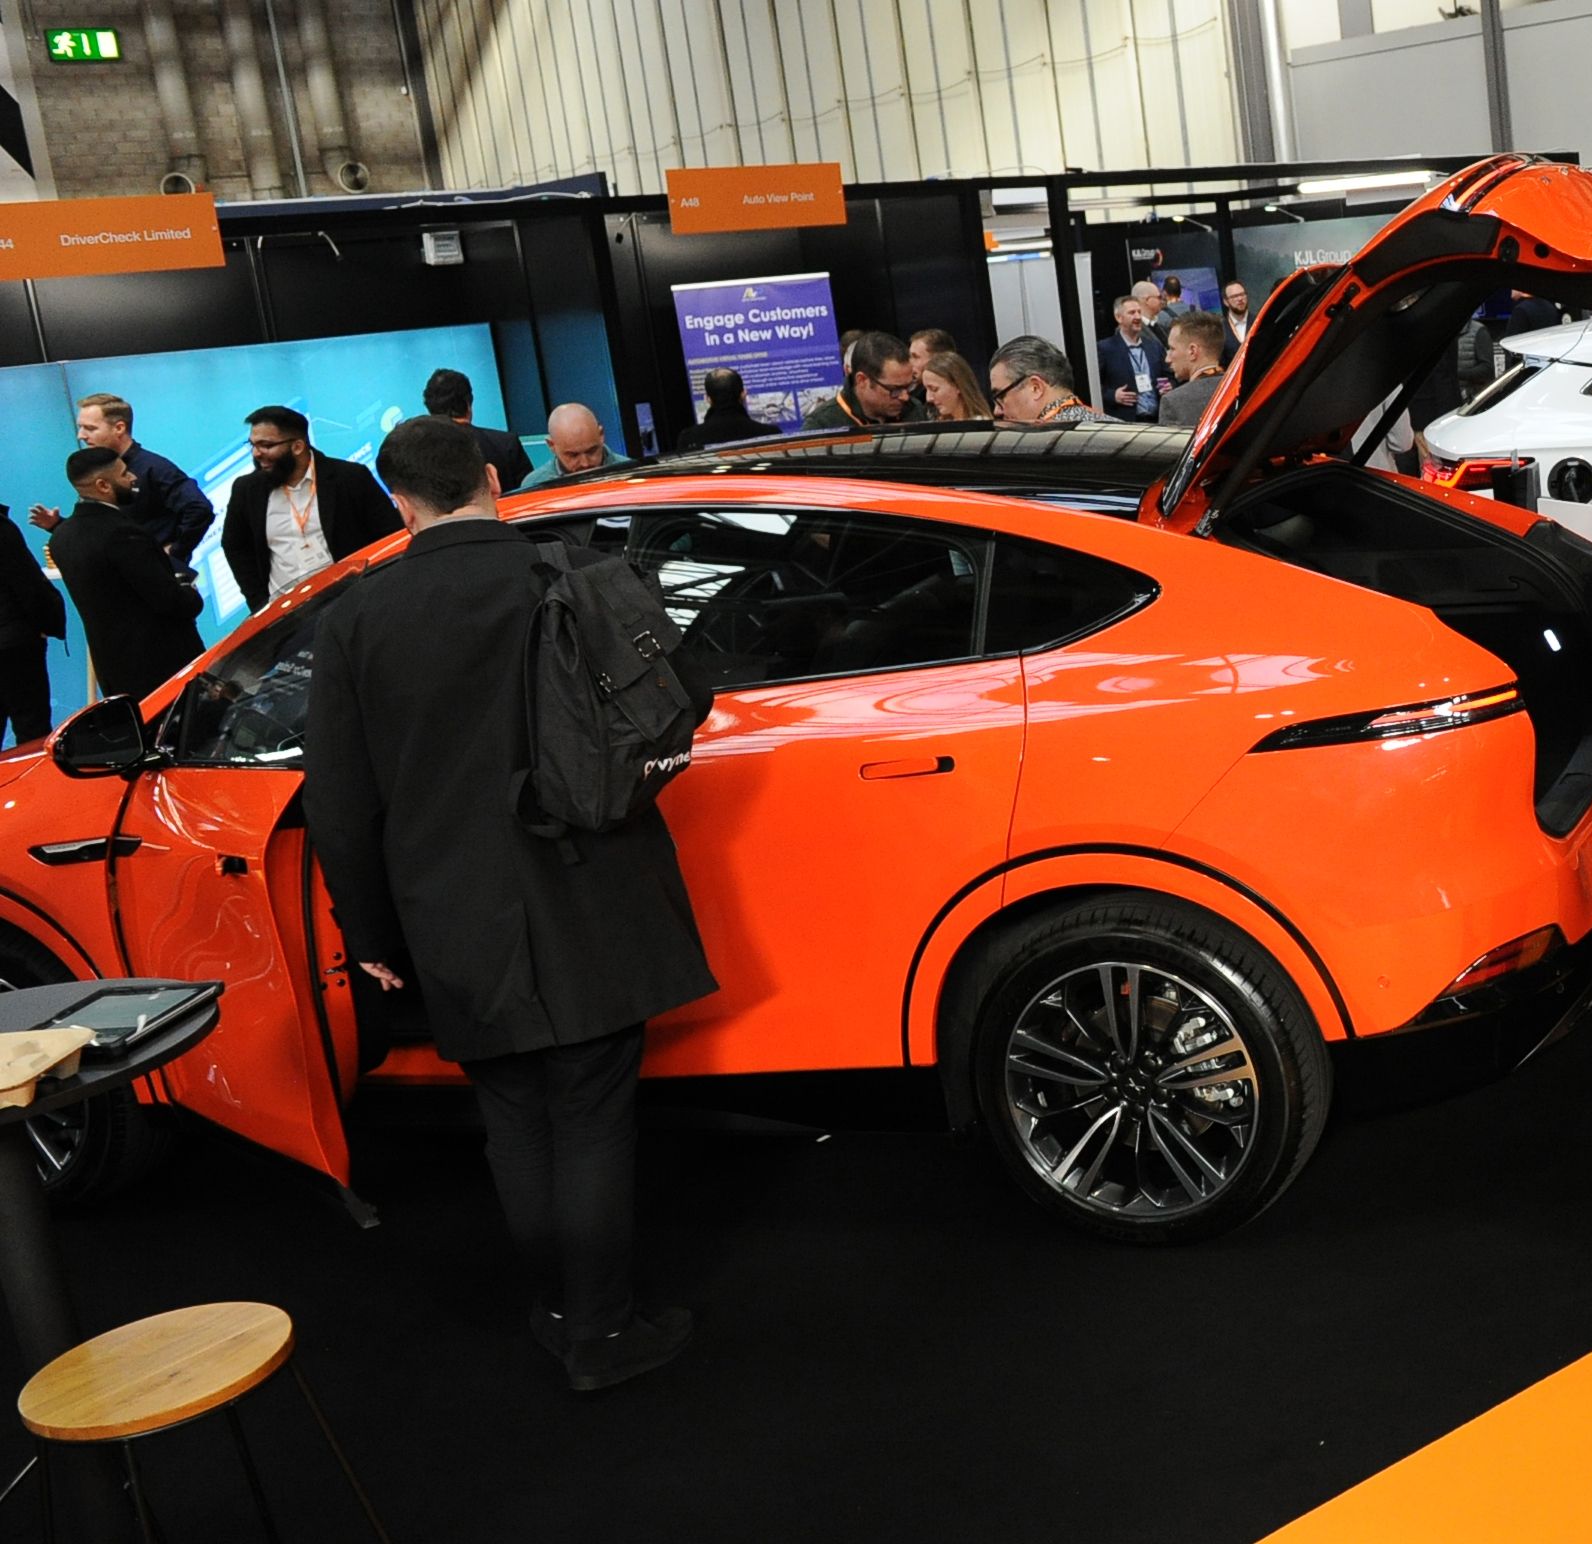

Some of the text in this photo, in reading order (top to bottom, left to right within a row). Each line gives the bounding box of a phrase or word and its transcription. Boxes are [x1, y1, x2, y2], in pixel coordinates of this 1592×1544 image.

[680, 191, 815, 208] A48 Auto View Point
[59, 230, 141, 247] DriverCheck
[143, 227, 191, 242] Limited
[1293, 248, 1352, 266] KJL Group
[685, 304, 828, 331] Engage Customers
[723, 333, 735, 344] a
[737, 329, 772, 342] New
[775, 322, 815, 339] Way!
[657, 750, 691, 772] vyne
